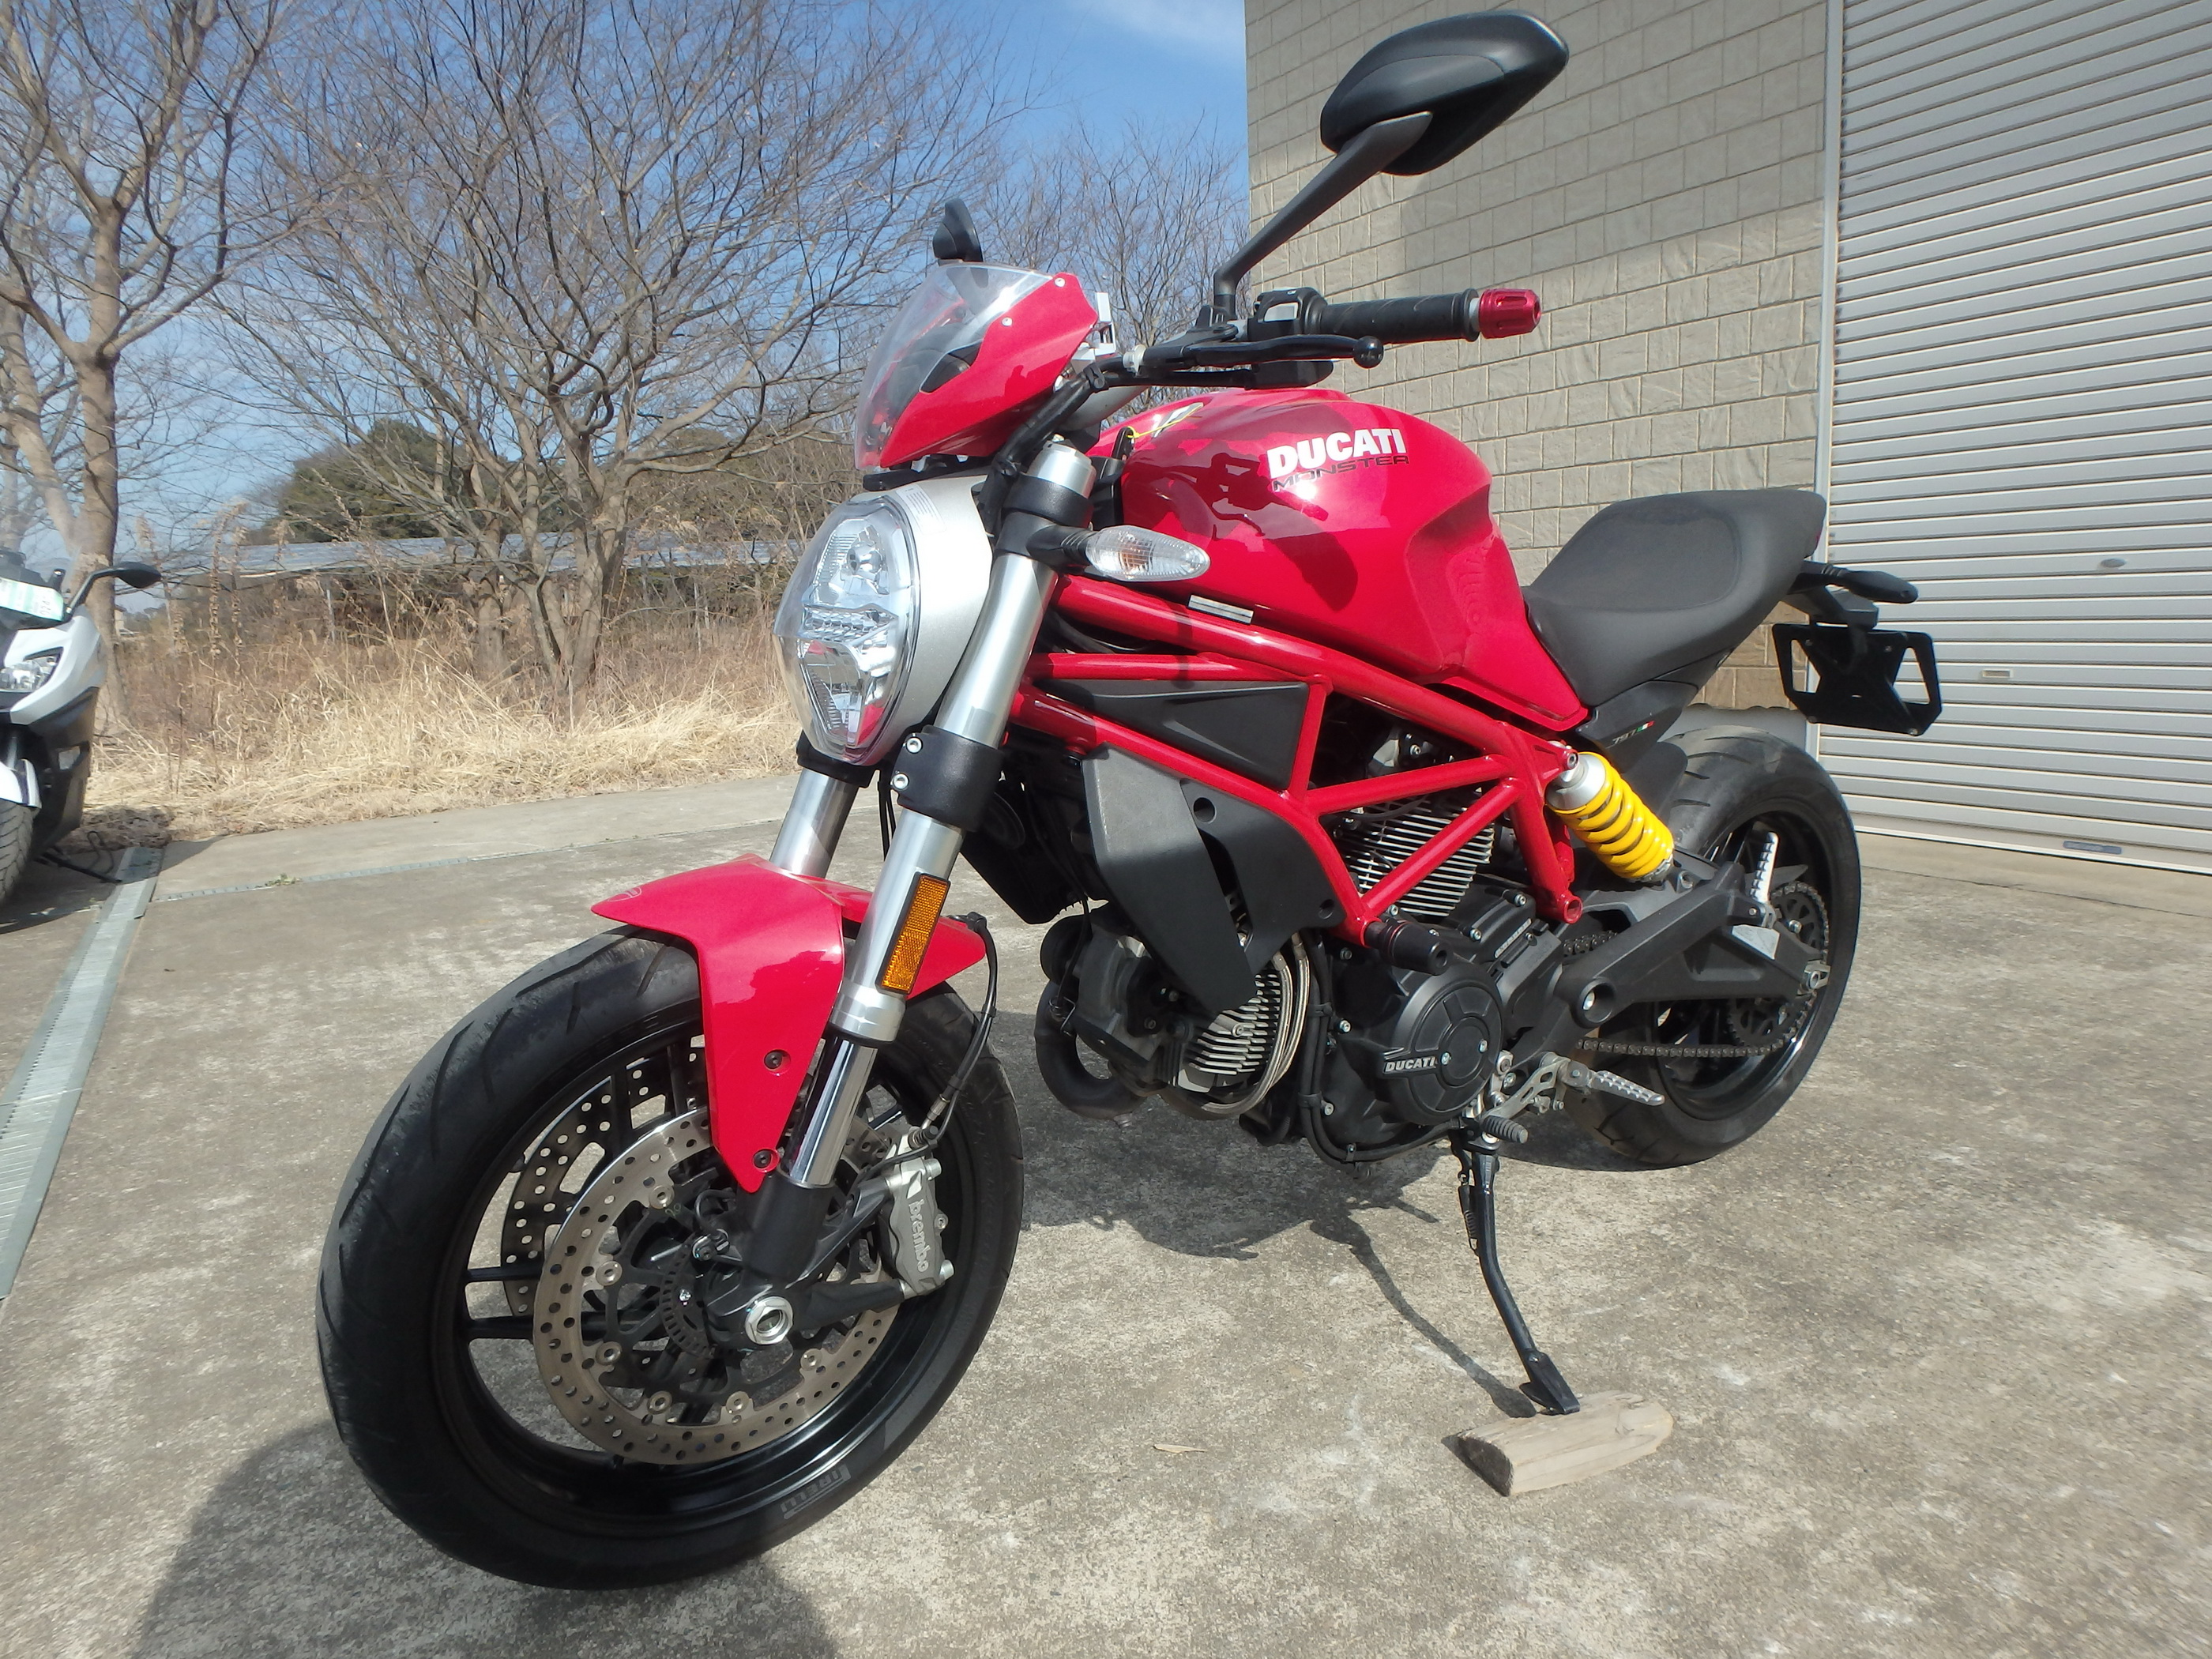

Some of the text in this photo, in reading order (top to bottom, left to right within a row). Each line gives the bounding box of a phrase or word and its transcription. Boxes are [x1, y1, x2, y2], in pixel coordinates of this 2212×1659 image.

[1266, 428, 1407, 480] DUCATI
[1272, 455, 1410, 492] MONSTER
[1385, 1055, 1436, 1072] DUCATI
[908, 1198, 931, 1273] brembo
[780, 1464, 852, 1520] PIRELLI
